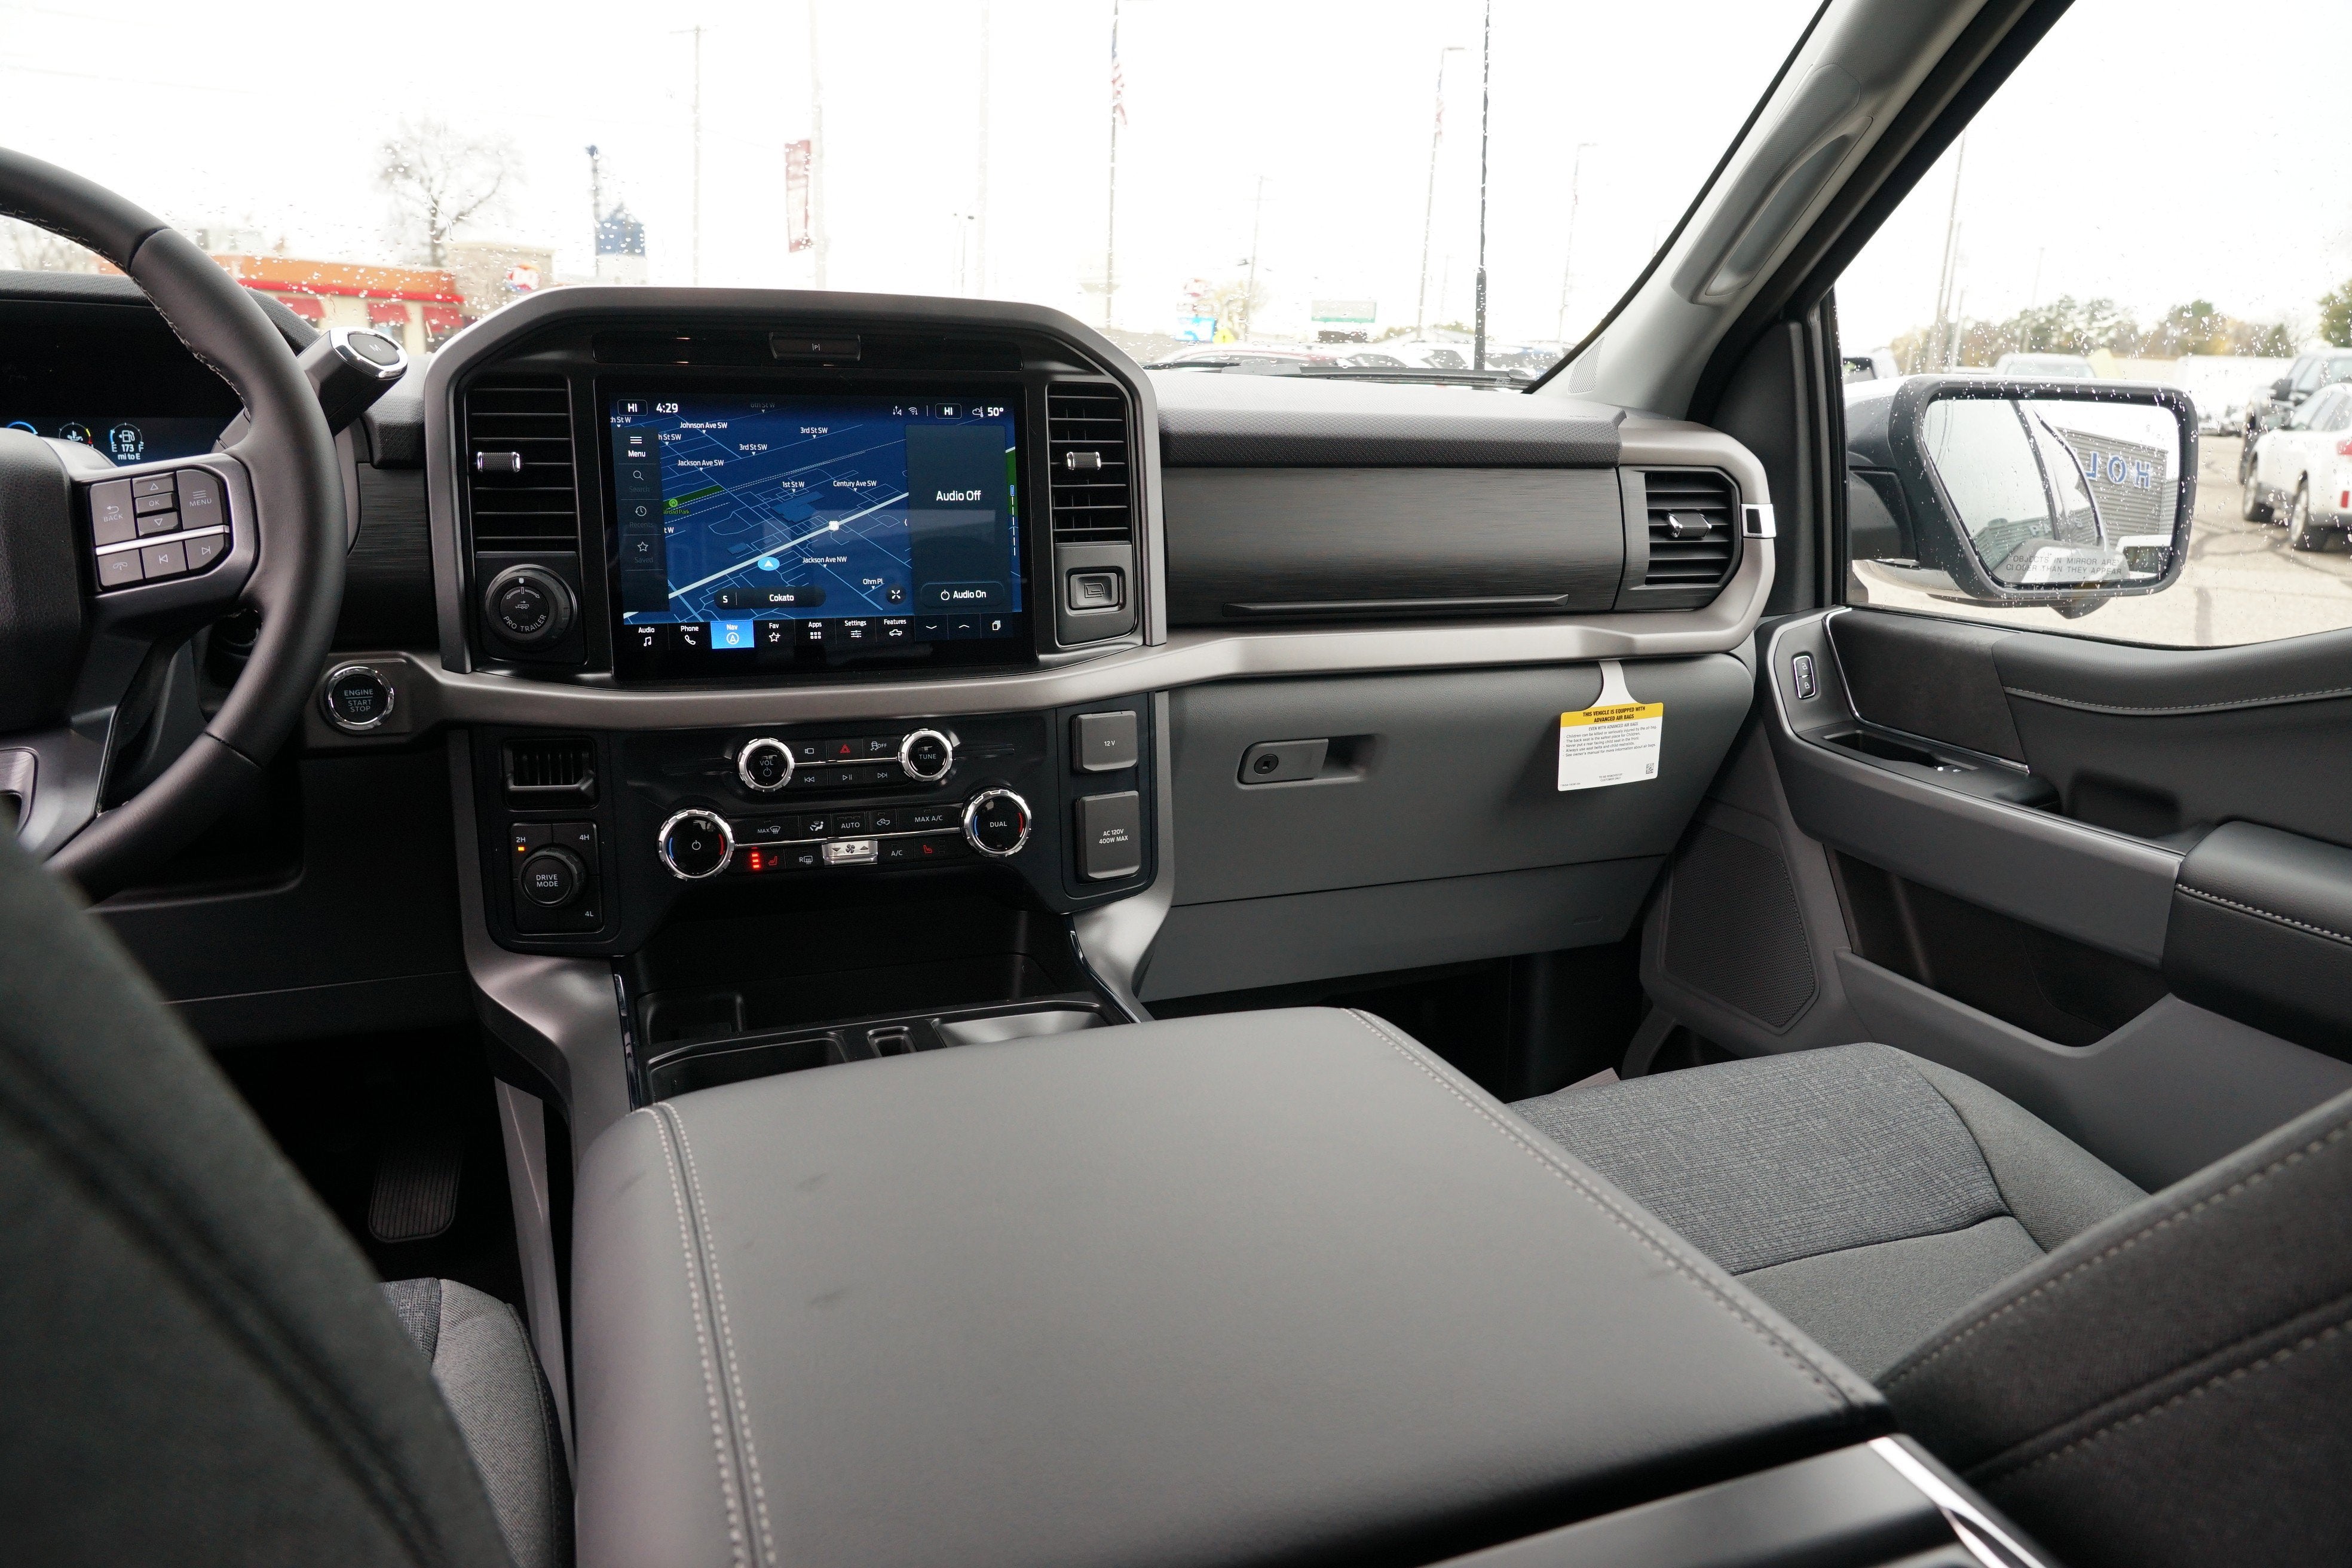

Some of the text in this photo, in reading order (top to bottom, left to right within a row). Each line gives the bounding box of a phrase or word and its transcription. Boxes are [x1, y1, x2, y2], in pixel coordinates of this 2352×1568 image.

[627, 403, 638, 412] HI
[656, 403, 678, 413] 4:29
[944, 407, 953, 416] HI
[987, 407, 1004, 417] 50°
[112, 444, 117, 452] E
[936, 490, 981, 501] Audio Off
[189, 498, 212, 507] MENU
[103, 514, 123, 522] BACK
[953, 590, 986, 599] Audio On
[503, 614, 546, 632] PRO TRAILER
